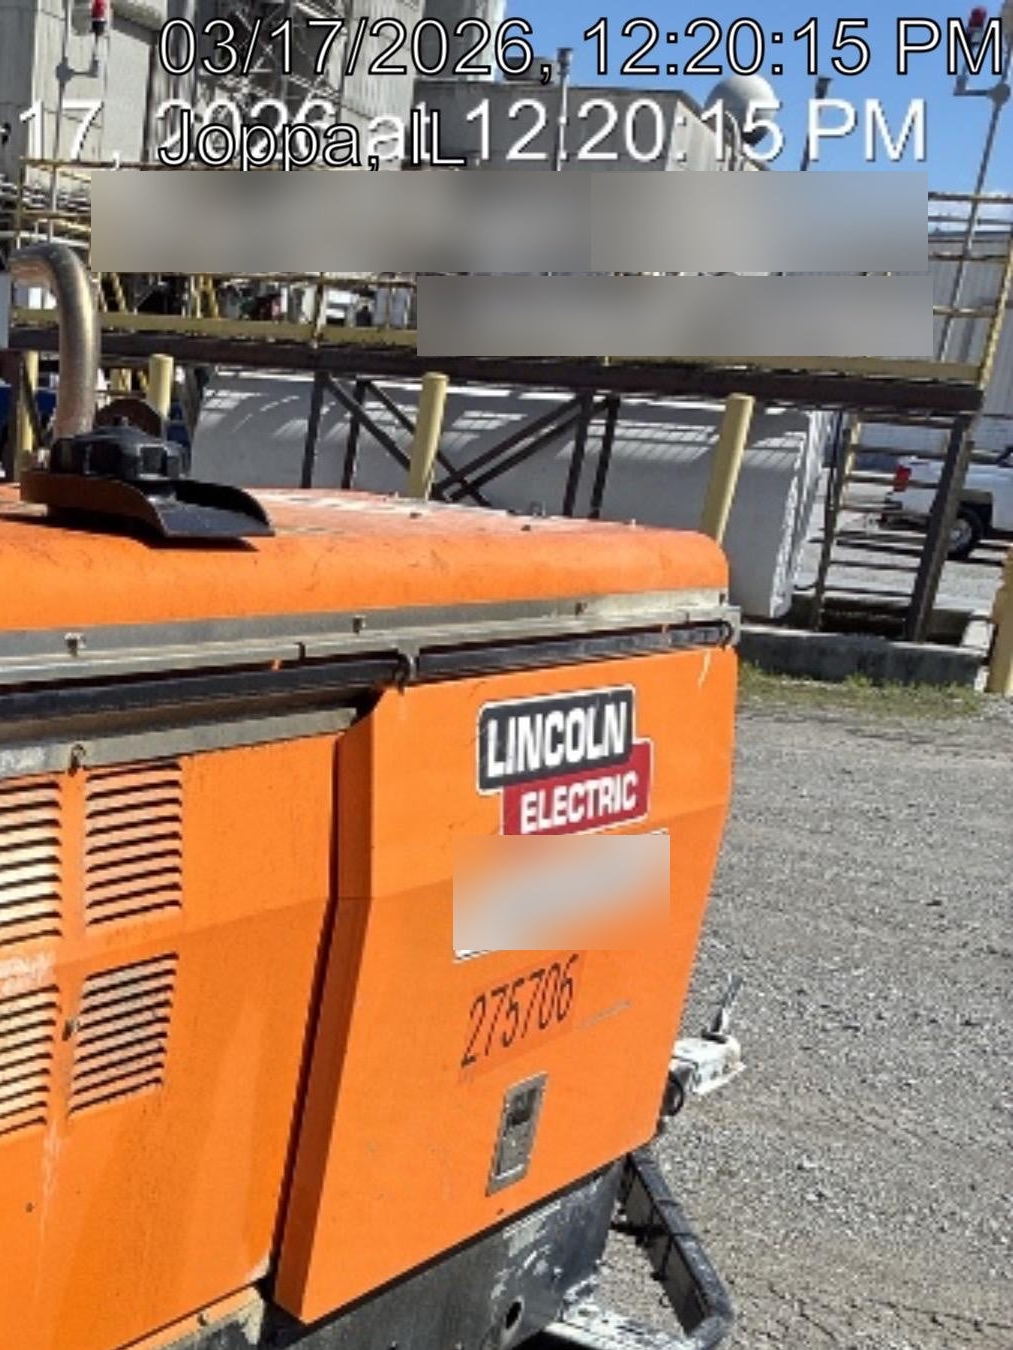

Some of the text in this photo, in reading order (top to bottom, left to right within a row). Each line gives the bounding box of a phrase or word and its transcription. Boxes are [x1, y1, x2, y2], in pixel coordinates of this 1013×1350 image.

[486, 701, 628, 778] LINCOLN
[520, 769, 639, 835] ELECTRIC
[461, 952, 580, 1068] 275706
